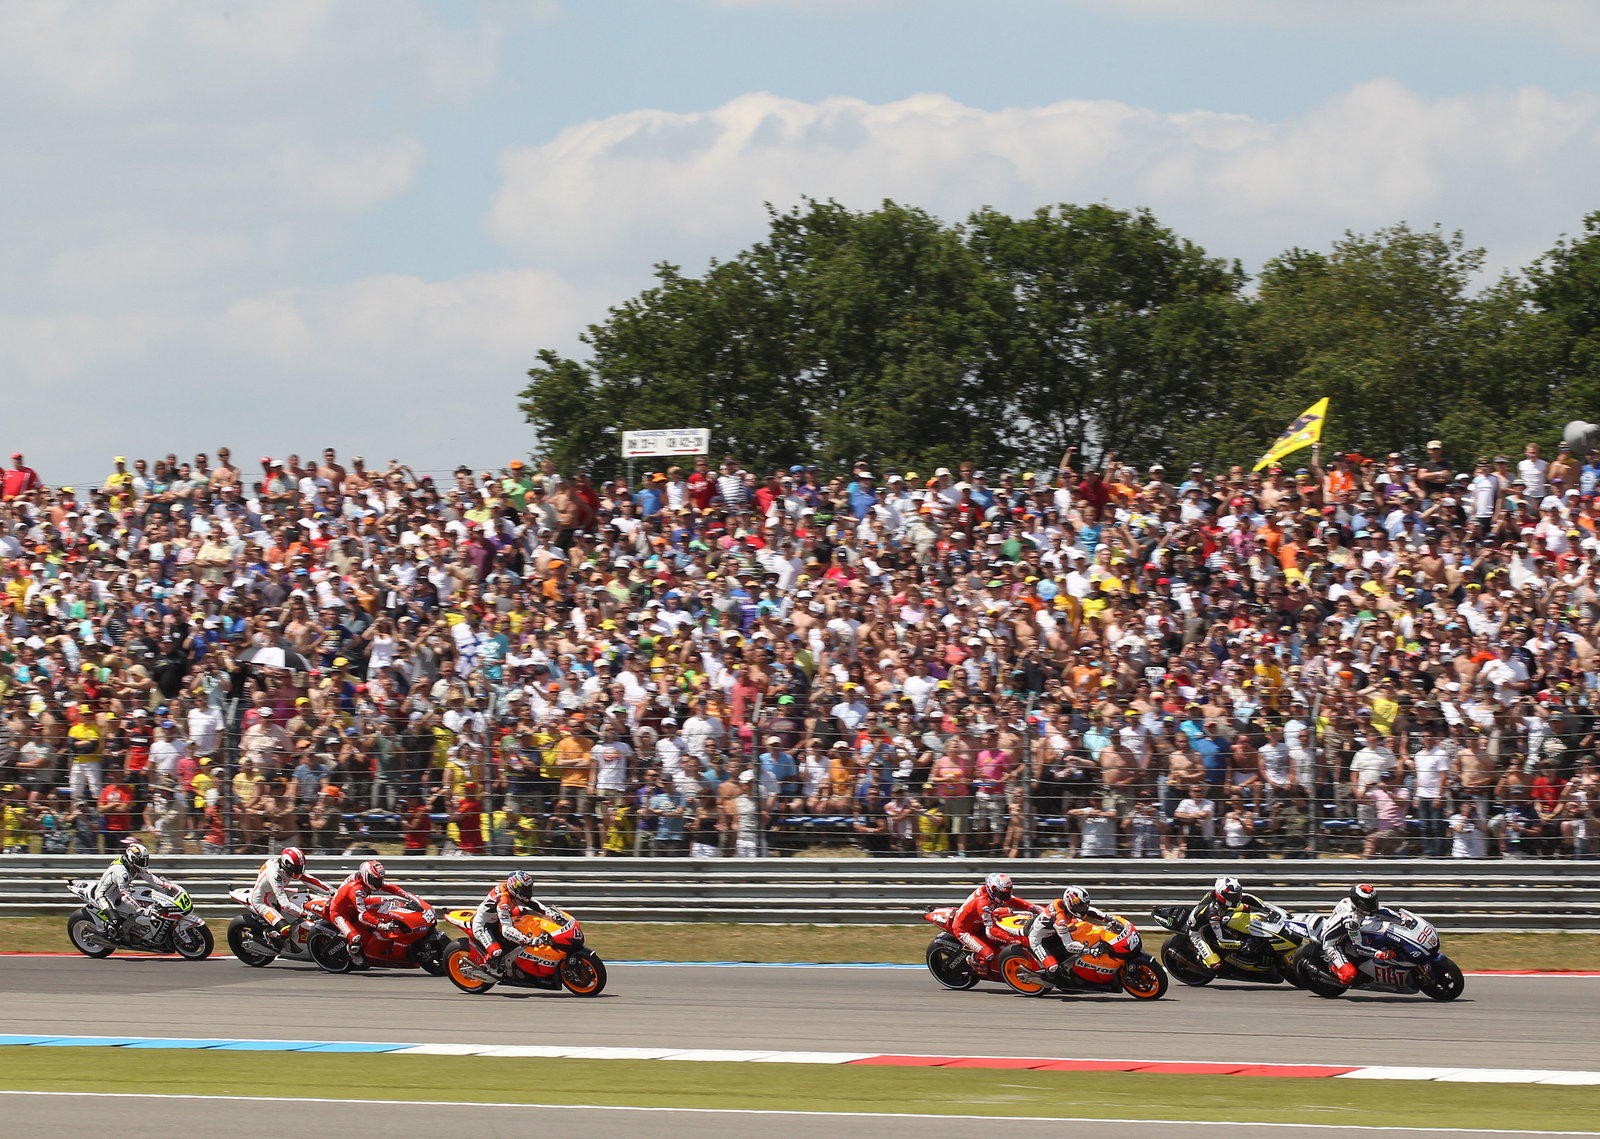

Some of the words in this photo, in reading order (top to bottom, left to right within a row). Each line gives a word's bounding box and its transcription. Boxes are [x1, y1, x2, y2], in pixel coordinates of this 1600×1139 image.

[180, 894, 191, 910] 14
[573, 927, 583, 939] 4
[519, 951, 559, 967] REPSOL
[1076, 959, 1116, 975] REPSOL
[1374, 965, 1406, 988] FIAT
